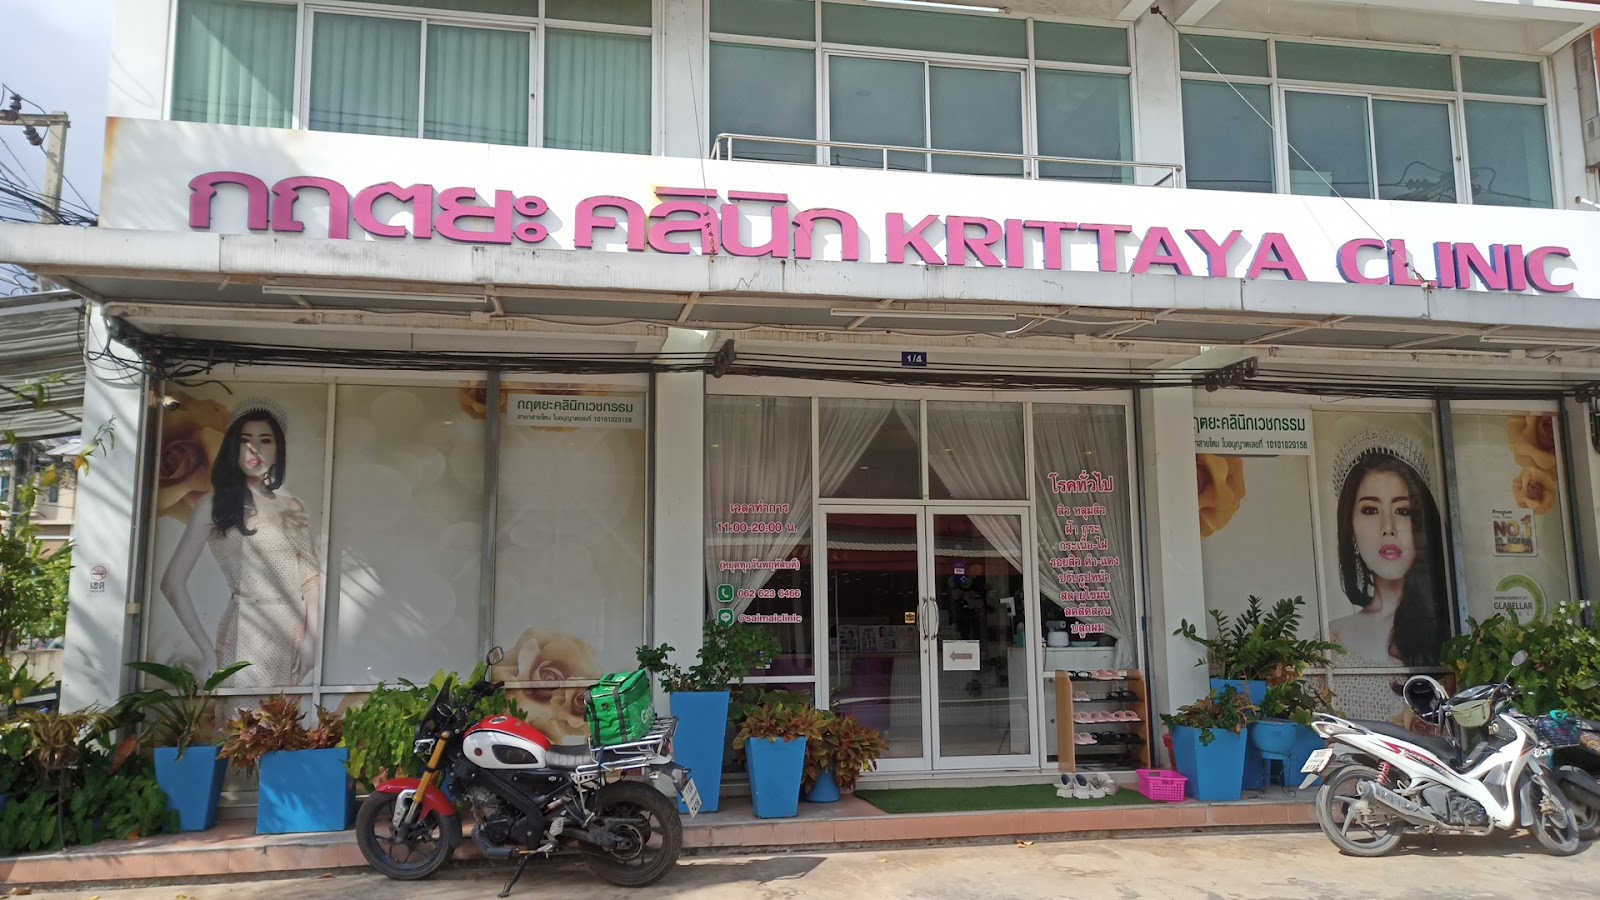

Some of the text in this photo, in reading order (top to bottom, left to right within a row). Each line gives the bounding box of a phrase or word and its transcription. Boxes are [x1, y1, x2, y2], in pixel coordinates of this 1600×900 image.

[188, 171, 859, 261] กฤตยะ คลินิก
[884, 211, 1576, 293] KRITTAYA CLINIC
[906, 354, 923, 363] 1/4
[1266, 440, 1308, 449] 10101020158
[1047, 469, 1114, 493] โรคทั่วไป
[730, 499, 790, 514] เวลาทำการ
[716, 521, 783, 534] 11:00-20:00
[778, 588, 801, 599] 6466
[738, 613, 802, 624] @saimaiclinic
